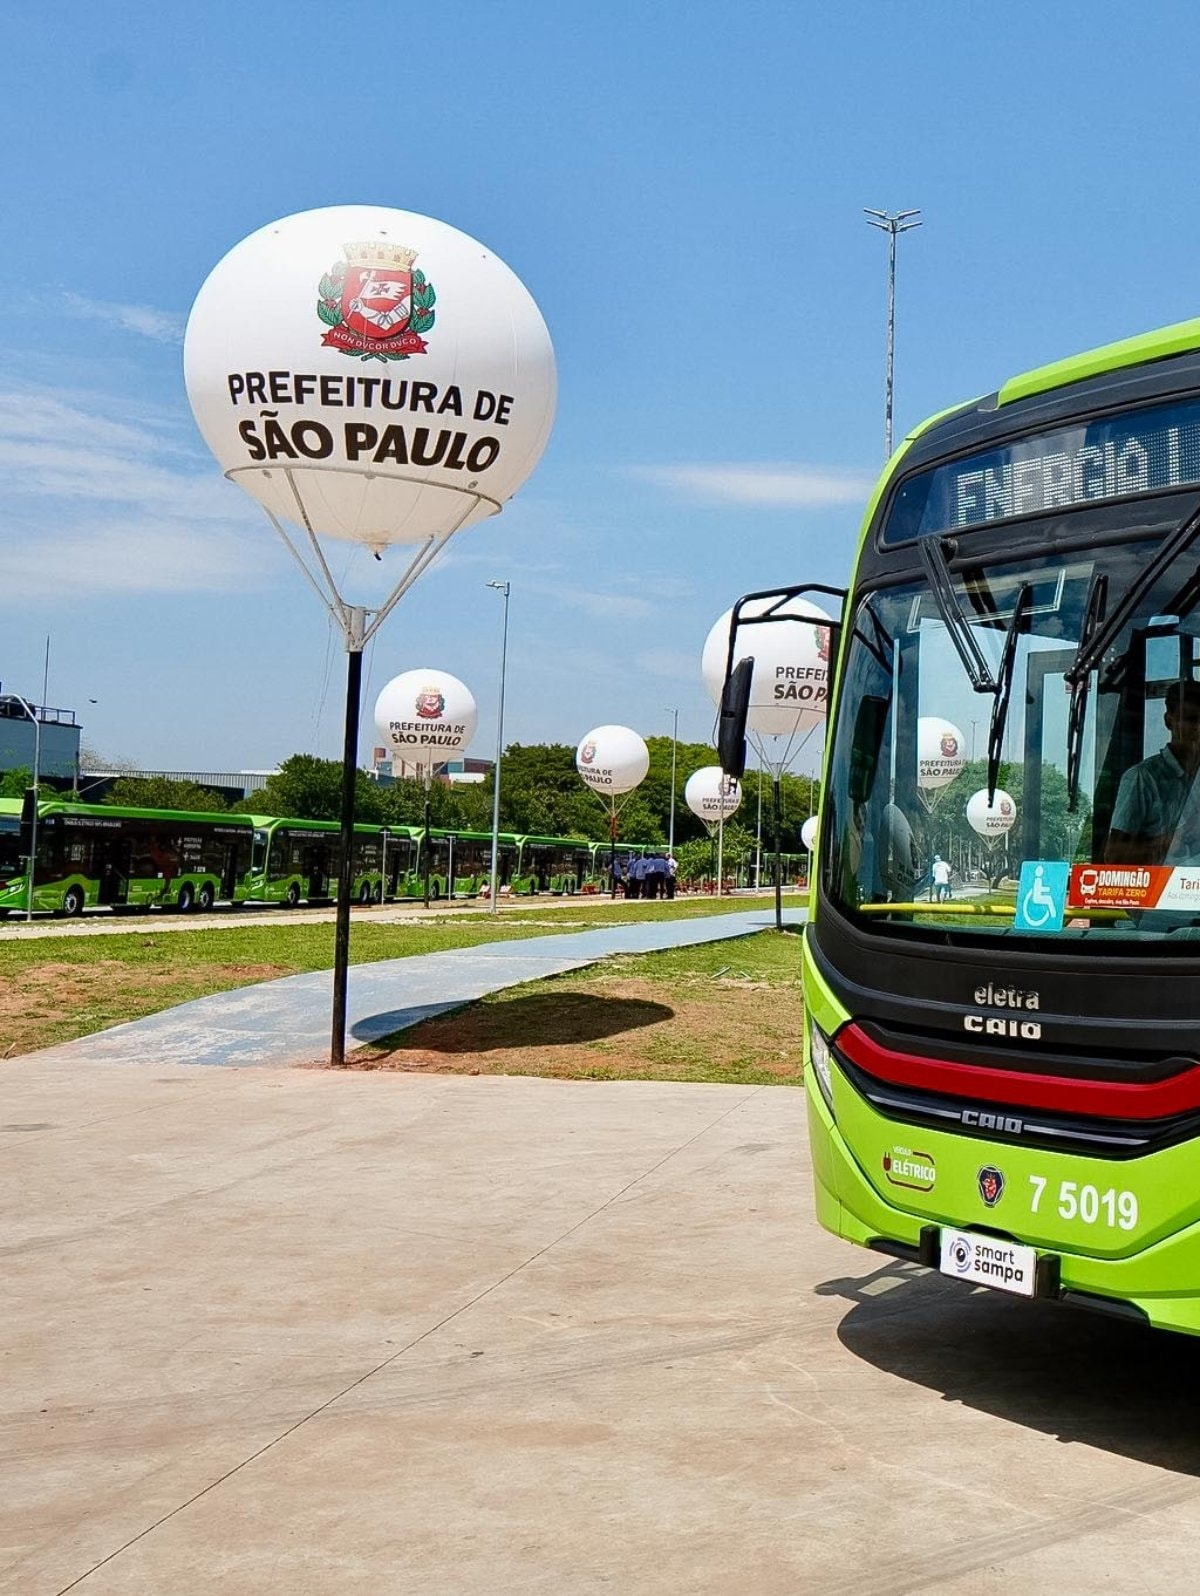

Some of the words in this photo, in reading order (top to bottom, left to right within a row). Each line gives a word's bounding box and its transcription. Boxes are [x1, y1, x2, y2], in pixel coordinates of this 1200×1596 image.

[228, 371, 463, 416] PREFEITURA
[473, 390, 515, 425] DE
[238, 411, 334, 461] SÃO
[345, 422, 501, 473] PAULO
[774, 681, 813, 700] SÃO
[389, 721, 452, 733] PREFEITURA
[454, 725, 466, 734] DE
[391, 731, 418, 744] SÃO
[420, 734, 461, 746] PAULO
[1098, 868, 1150, 888] DOMINGÃO
[1098, 888, 1124, 896] TARIFA
[1126, 889, 1147, 897] ZERO
[974, 982, 1040, 1009] eletra
[964, 1015, 1041, 1040] CAIO
[961, 1110, 1023, 1134] CAIO
[893, 1159, 936, 1182] ELÉTRICO
[1029, 1175, 1047, 1213] 7
[1058, 1181, 1139, 1231] 5019
[975, 1243, 1015, 1265] smart
[974, 1259, 1024, 1283] sampa
